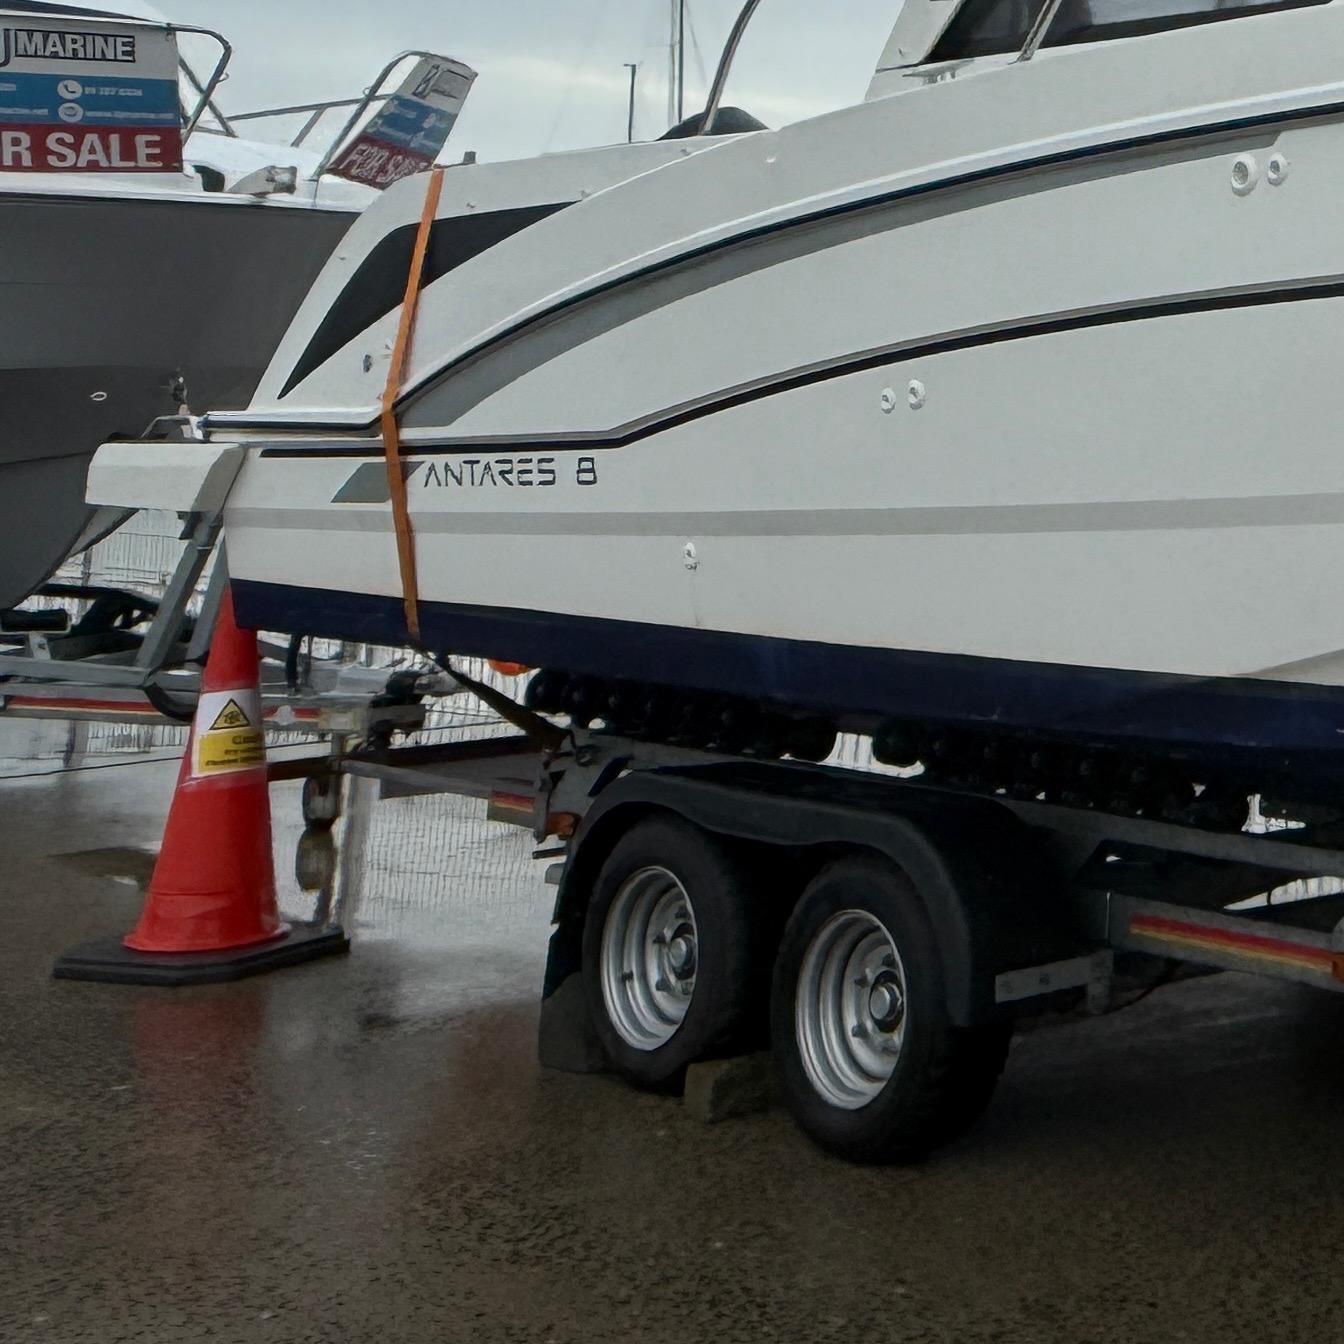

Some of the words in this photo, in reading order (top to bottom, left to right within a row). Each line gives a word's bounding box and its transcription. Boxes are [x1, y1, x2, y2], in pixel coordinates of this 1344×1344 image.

[15, 30, 135, 61] MARINE
[46, 131, 164, 168] SALE
[424, 457, 556, 488] ANTARES
[576, 456, 598, 486] 8
